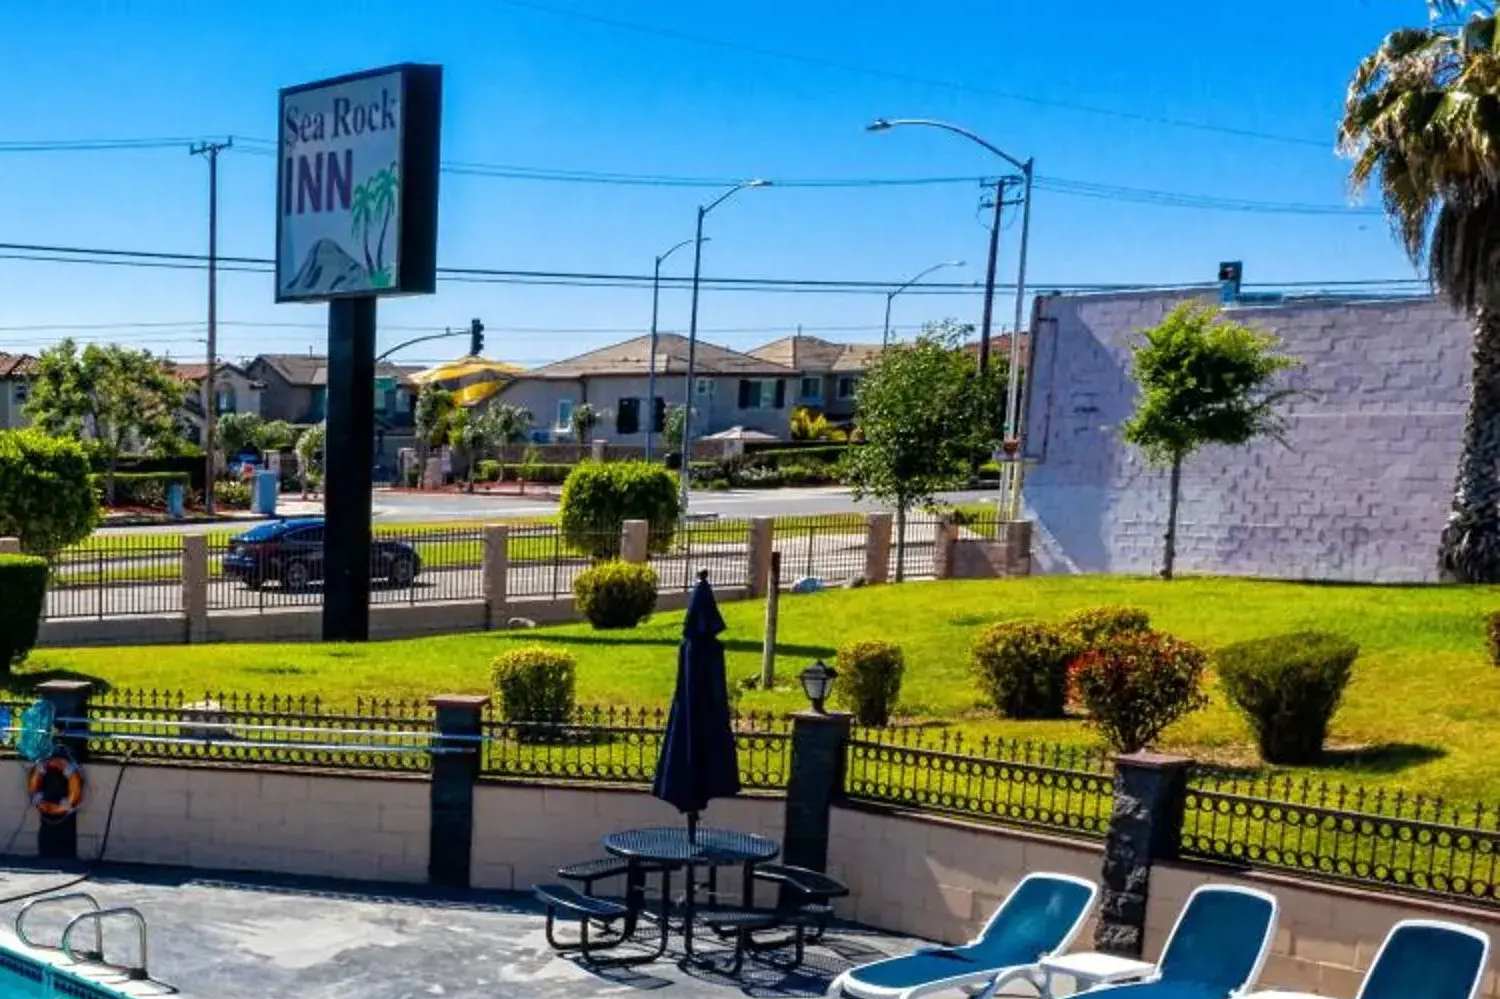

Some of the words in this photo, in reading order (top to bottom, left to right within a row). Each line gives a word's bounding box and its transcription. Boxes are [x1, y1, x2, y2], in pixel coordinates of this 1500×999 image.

[284, 104, 325, 148] Sea
[331, 88, 398, 139] Rock
[284, 149, 353, 217] INN
